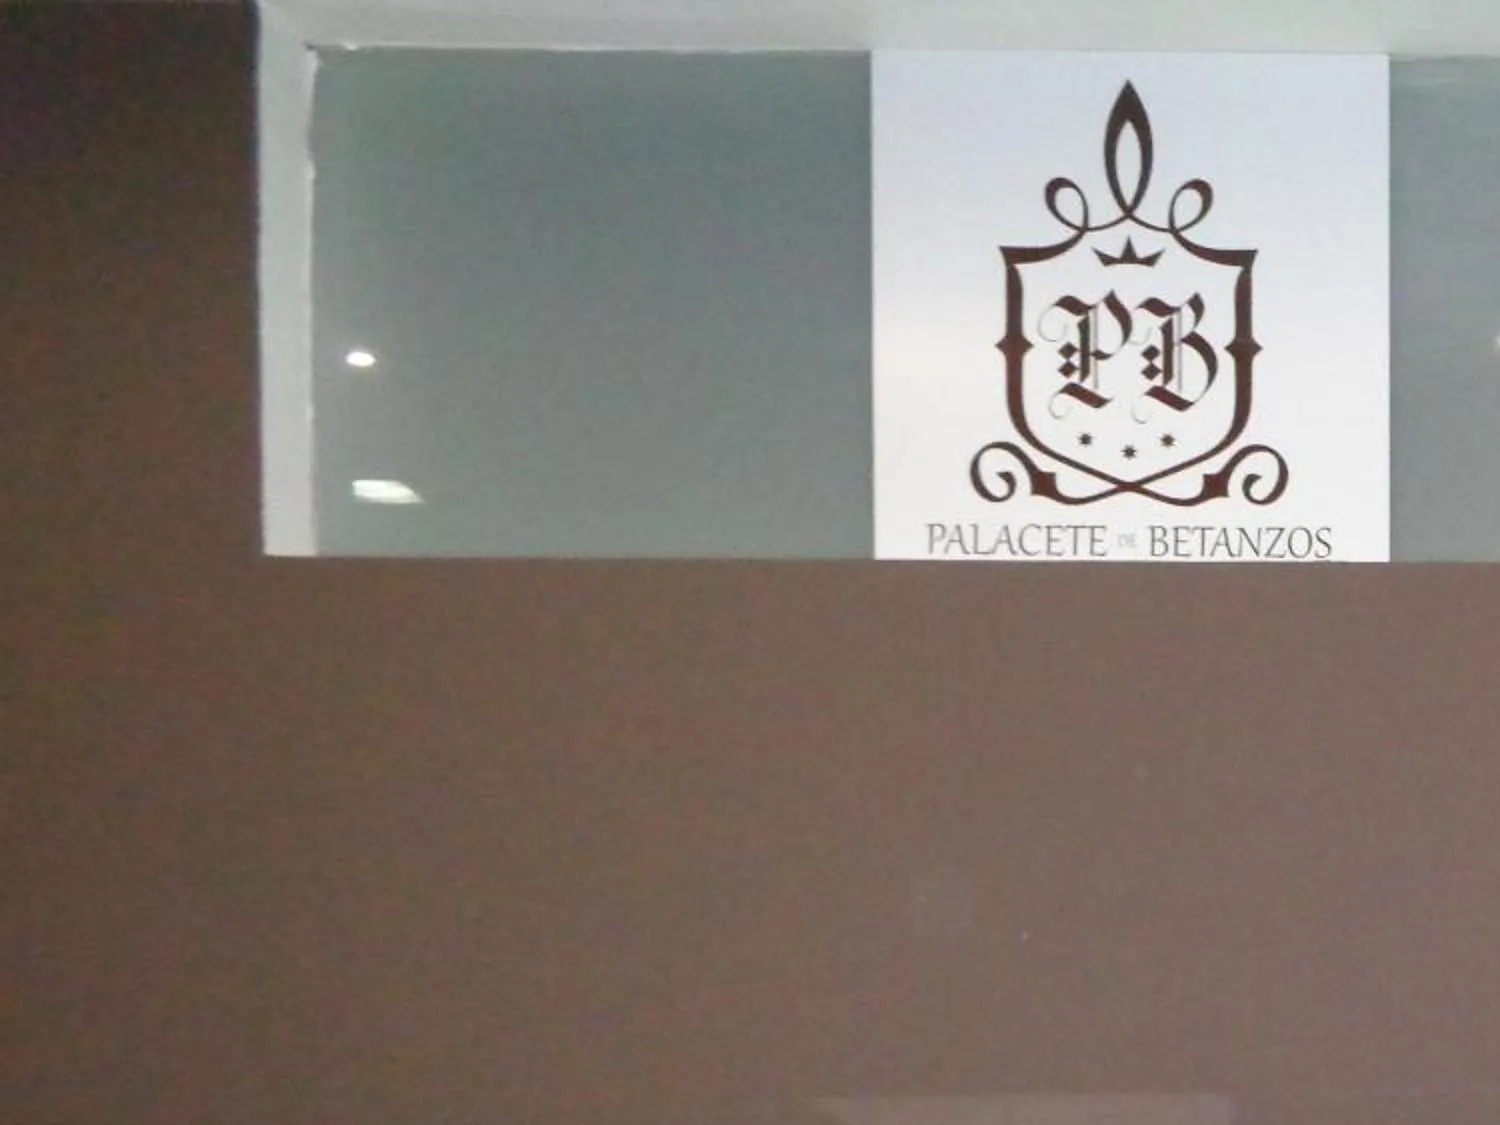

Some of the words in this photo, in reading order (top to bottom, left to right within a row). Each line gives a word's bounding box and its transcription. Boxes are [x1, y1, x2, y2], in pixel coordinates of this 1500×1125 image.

[926, 522, 1107, 556] PALACETE
[1118, 532, 1138, 547] DE
[1148, 525, 1333, 559] BETANZOS
